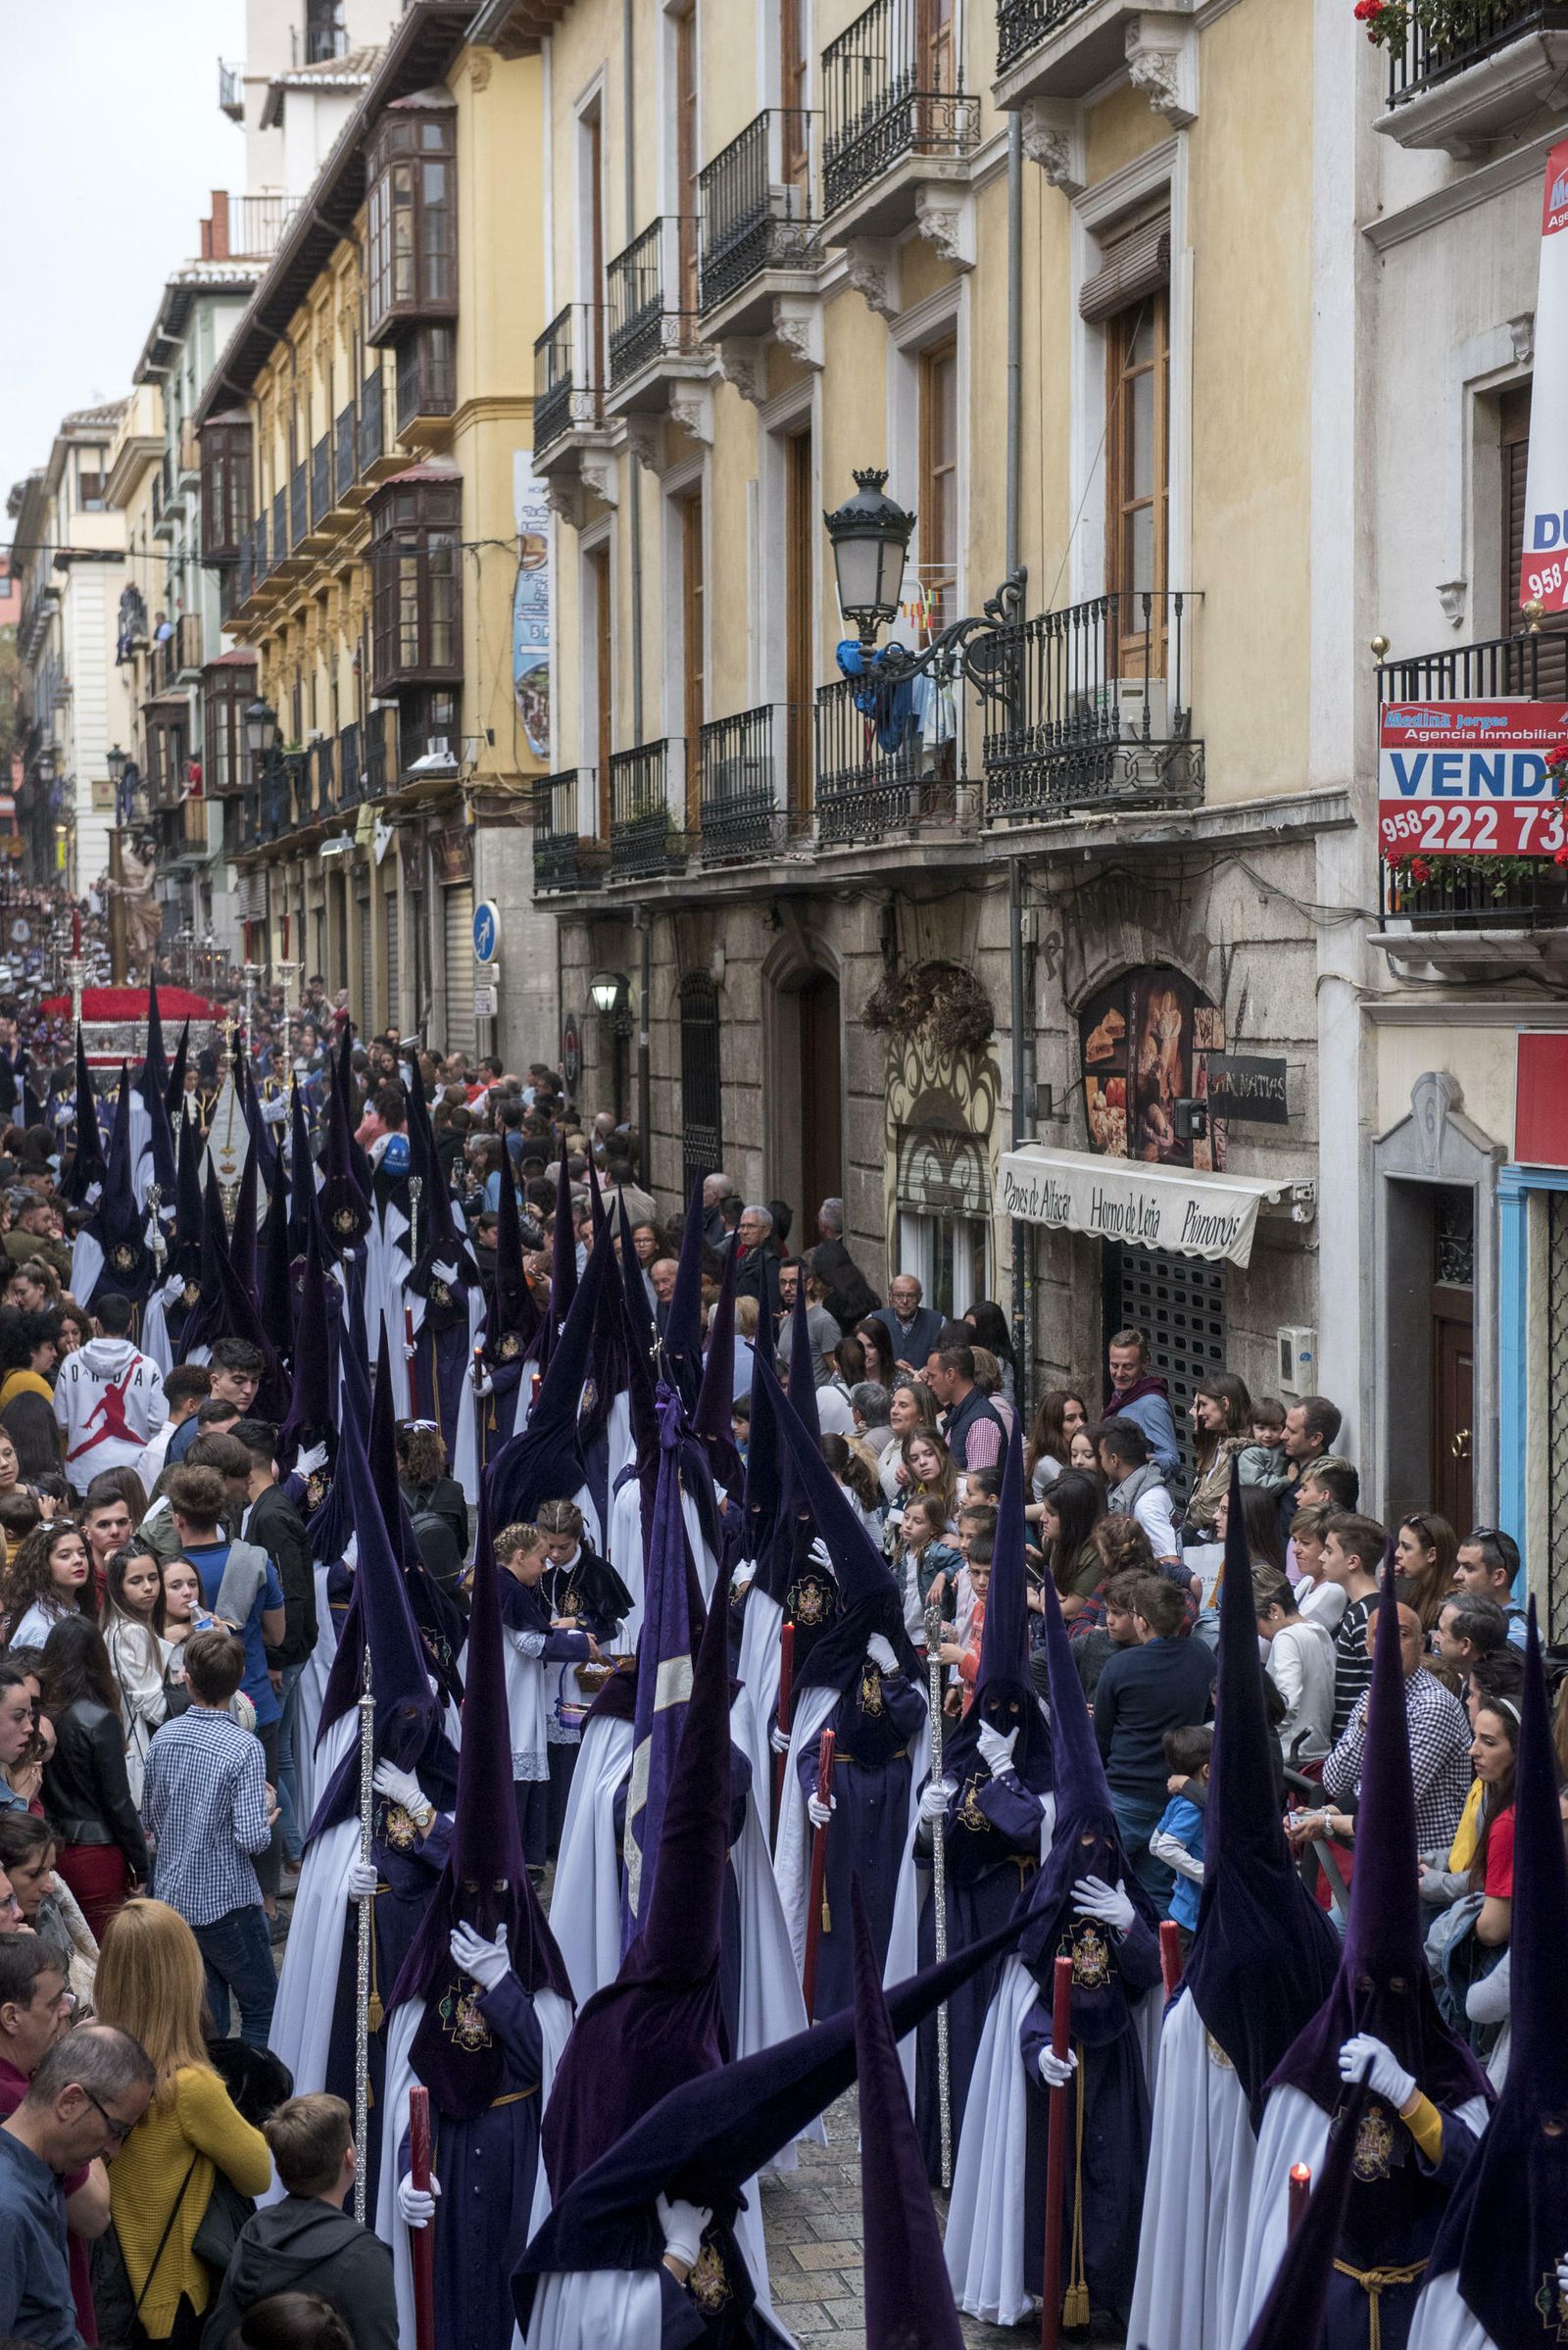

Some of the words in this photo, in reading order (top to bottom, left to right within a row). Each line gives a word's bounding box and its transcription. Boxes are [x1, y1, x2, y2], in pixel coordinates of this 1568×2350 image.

[1534, 510, 1568, 550] D
[1529, 563, 1562, 599] 958
[1384, 709, 1451, 728] Medina
[1404, 728, 1476, 742] Agencia
[1381, 809, 1423, 843] 958
[1419, 805, 1498, 849] 222
[1513, 806, 1568, 851] 73
[1426, 1096, 1436, 1135] 6
[1004, 1171, 1028, 1214] Panes
[1029, 1177, 1039, 1216] de
[1040, 1179, 1072, 1221] Alfacar
[1090, 1186, 1124, 1231] Horno
[1126, 1193, 1137, 1235] de
[1138, 1194, 1161, 1240] Leña
